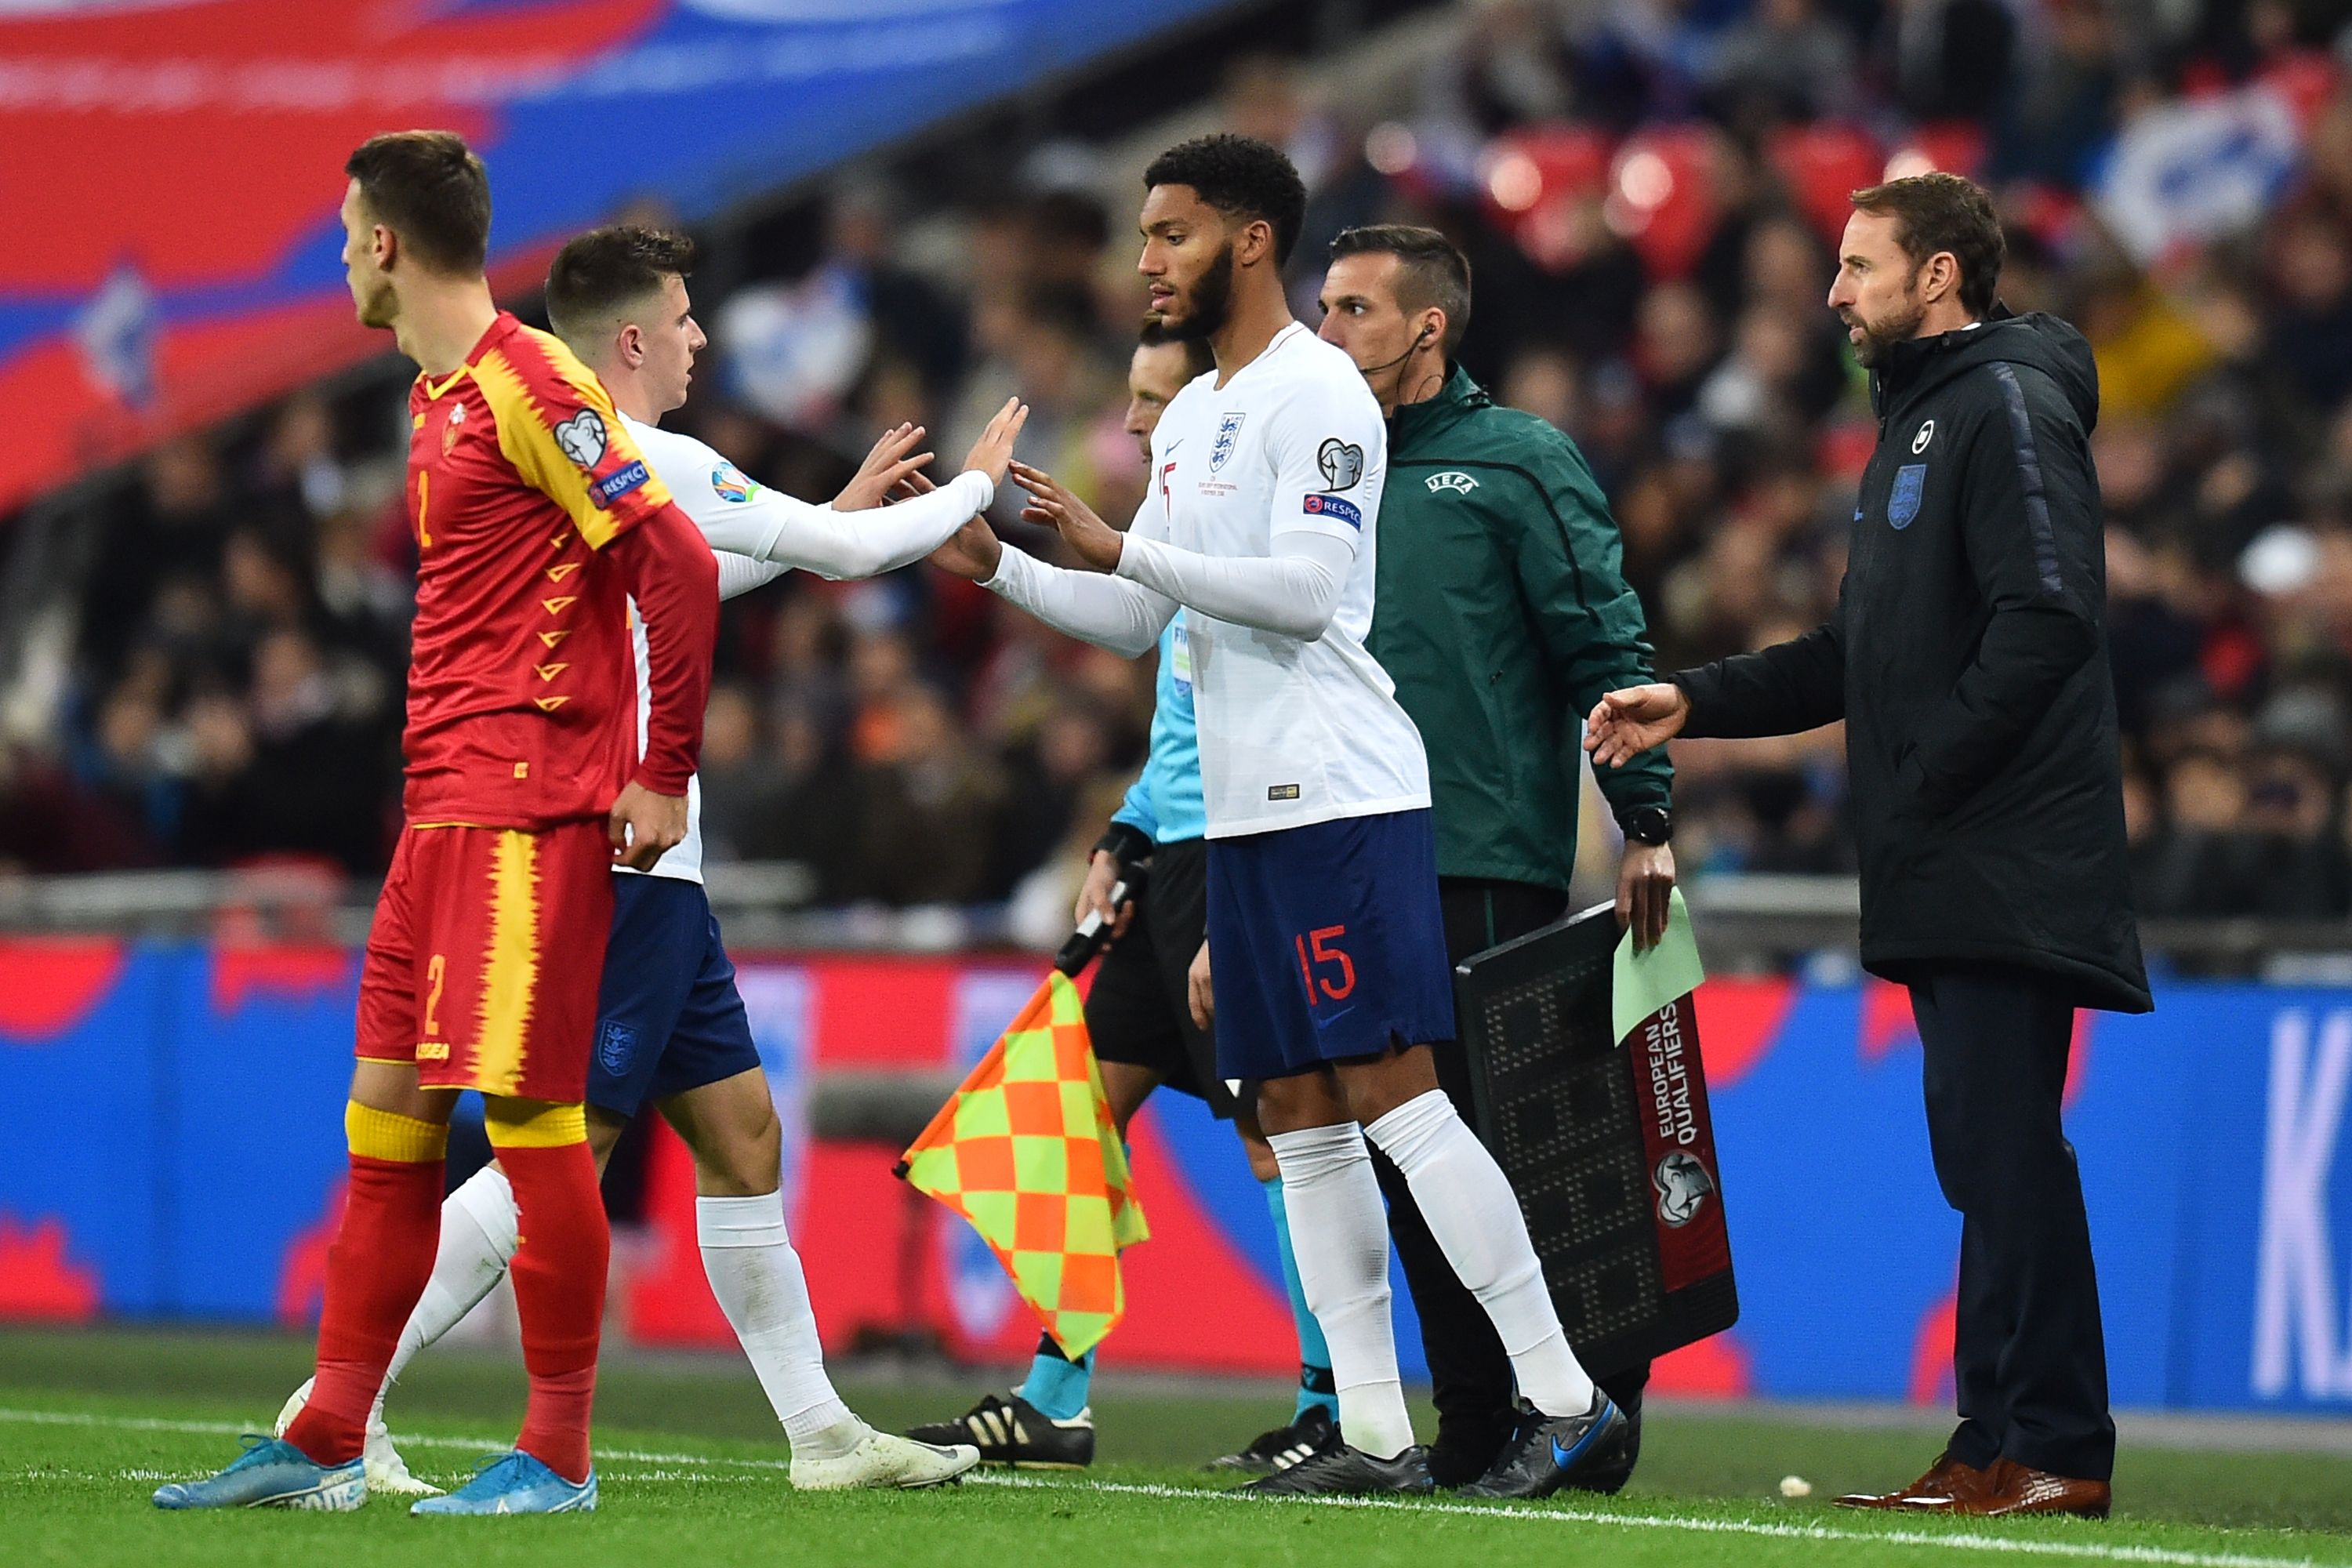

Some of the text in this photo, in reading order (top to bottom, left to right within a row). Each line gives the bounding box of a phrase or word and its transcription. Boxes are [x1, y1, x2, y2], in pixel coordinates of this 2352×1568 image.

[602, 465, 647, 496] RESPECT
[1323, 501, 1361, 524] RESPEC
[1427, 475, 1474, 493] UEFA
[424, 954, 446, 1036] 2
[1295, 925, 1356, 1007] 15
[1645, 1023, 1675, 1138] EUROPEAN
[1659, 1002, 1698, 1145] QUALIFIERS
[2250, 1007, 2352, 1399] K
